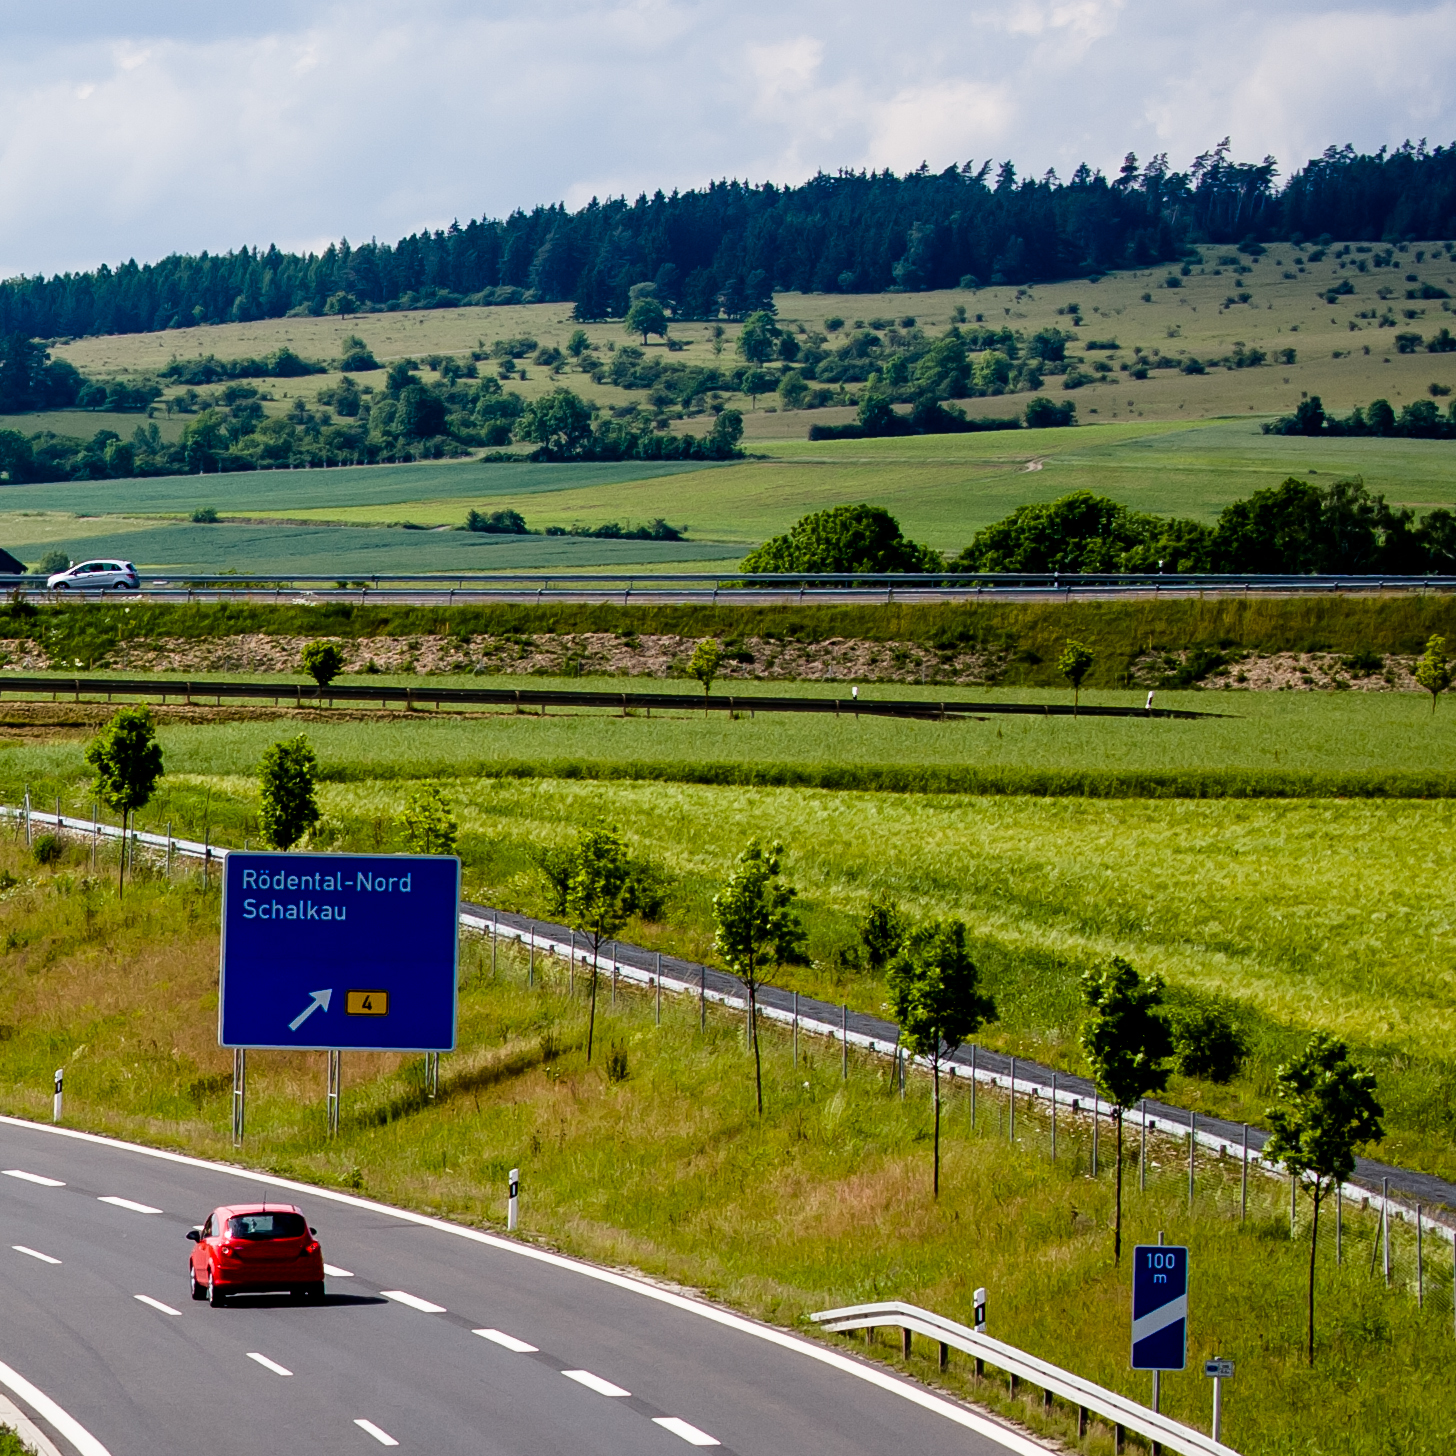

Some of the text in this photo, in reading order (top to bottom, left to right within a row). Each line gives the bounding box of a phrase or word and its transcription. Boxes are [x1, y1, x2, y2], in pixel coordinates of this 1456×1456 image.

[242, 869, 412, 892] Rödental-Nord
[242, 899, 347, 920] Schalkau
[361, 995, 373, 1011] 4
[1146, 1253, 1176, 1269] 100
[1153, 1273, 1167, 1284] m
